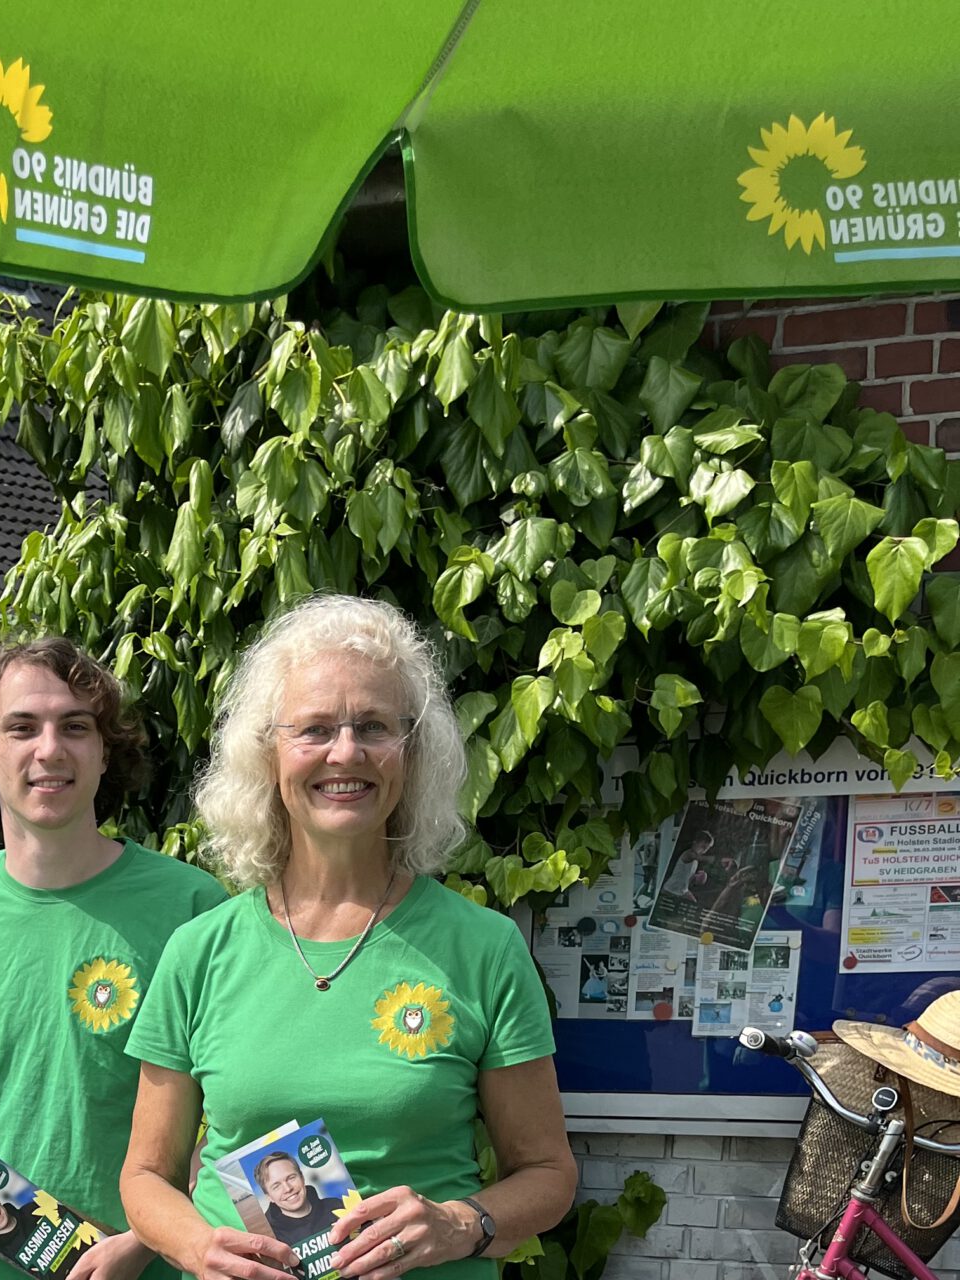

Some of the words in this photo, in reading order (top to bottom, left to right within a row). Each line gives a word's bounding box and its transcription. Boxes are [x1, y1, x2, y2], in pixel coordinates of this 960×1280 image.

[742, 768, 848, 787] Quickborn
[748, 812, 793, 829] Quickborn
[795, 811, 821, 850] Training
[890, 824, 960, 837] FUSSBALL
[897, 838, 930, 846] Holsten
[882, 855, 930, 864] HOLSTEIN
[879, 868, 892, 876] SV
[893, 866, 957, 875] HEIDGRABEN
[18, 1222, 52, 1265] RASMUS
[36, 1218, 76, 1271] ANDRESEN
[293, 1231, 334, 1261] RASM
